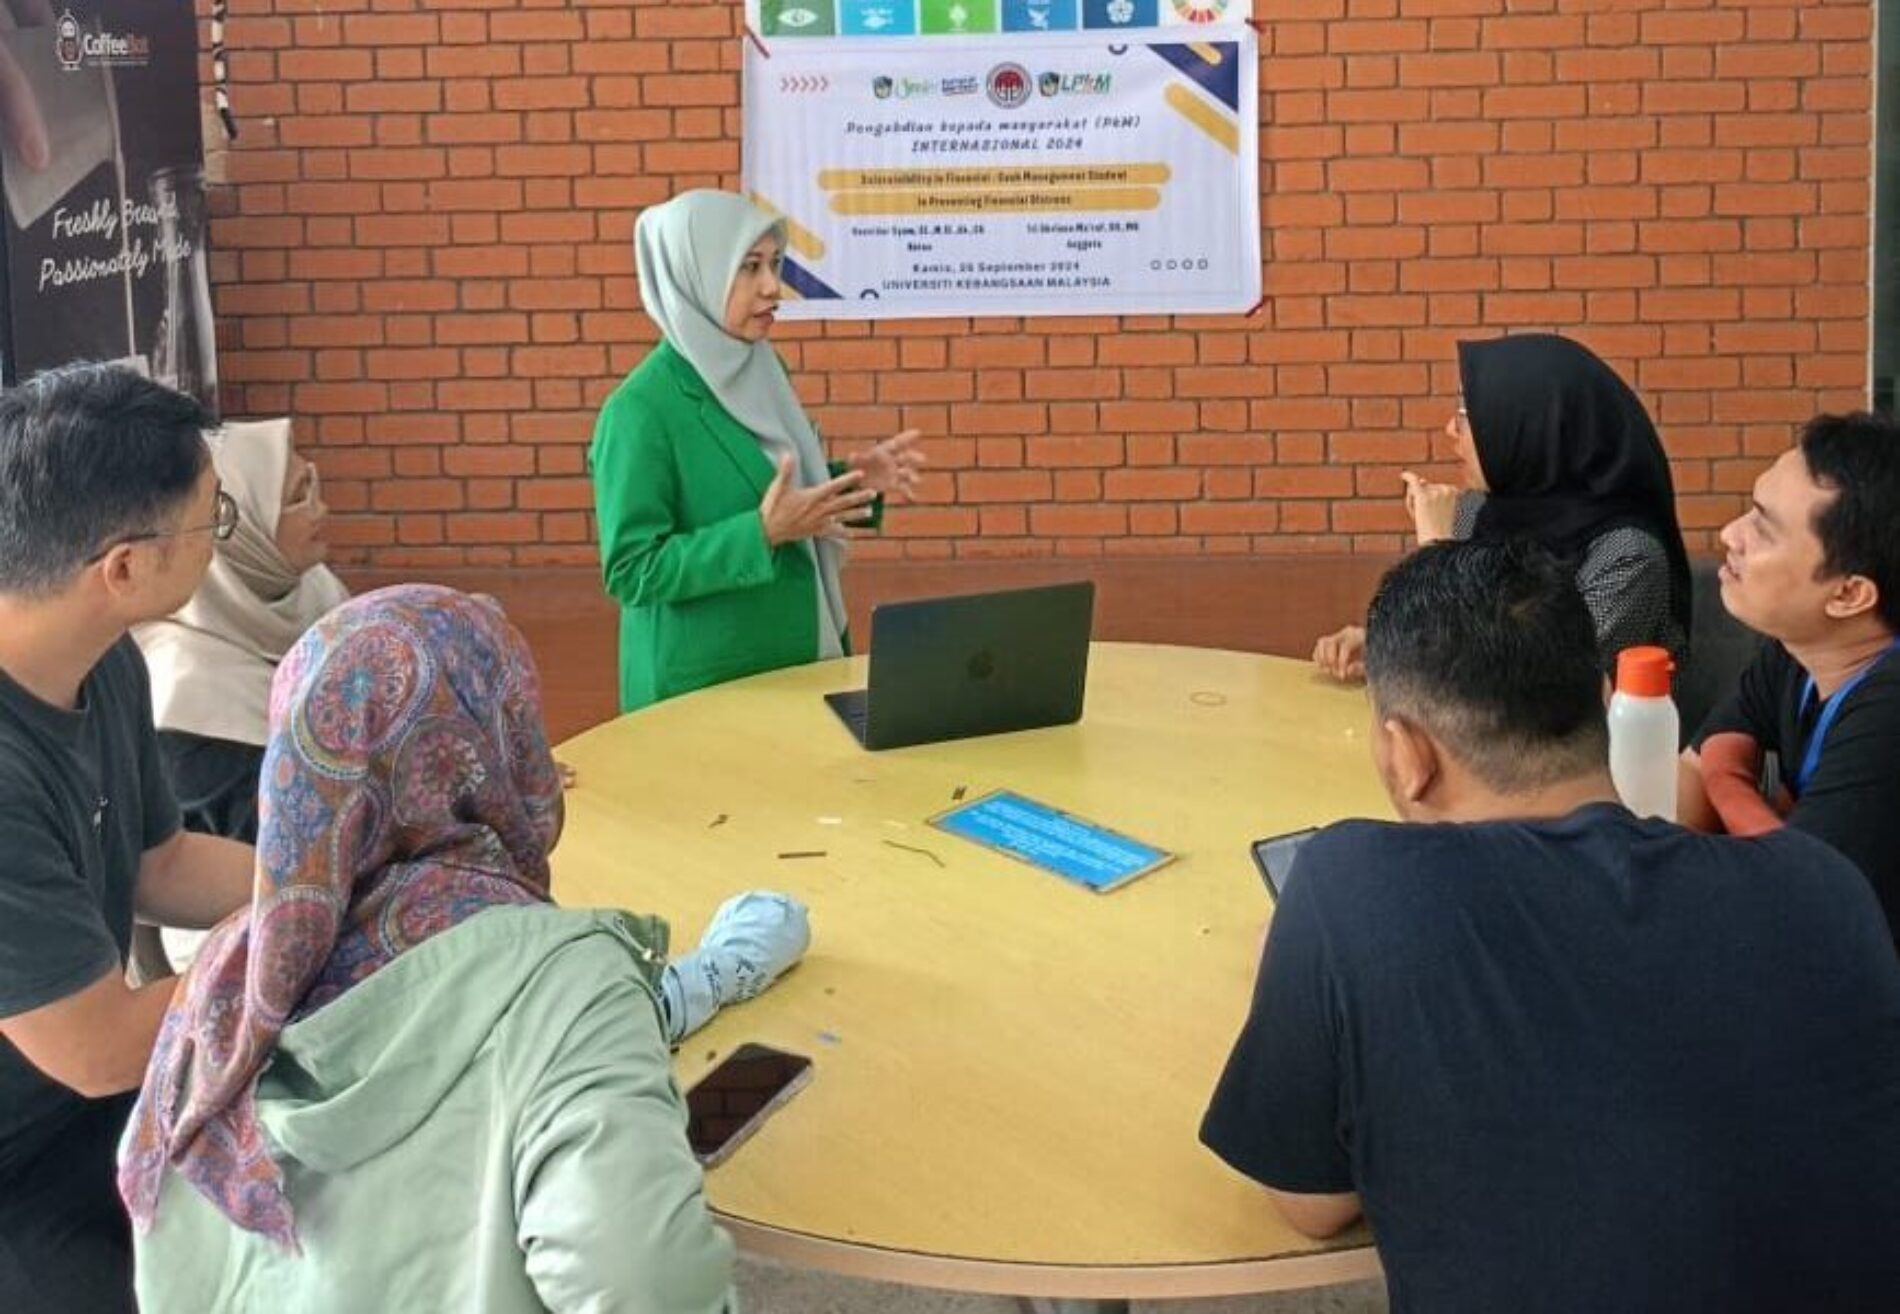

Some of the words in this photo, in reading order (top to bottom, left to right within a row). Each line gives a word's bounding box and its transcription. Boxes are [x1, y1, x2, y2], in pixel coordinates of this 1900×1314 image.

[1047, 138, 1083, 150] 2024
[52, 198, 118, 240] Freshly
[1047, 276, 1111, 288] MALAYSIA
